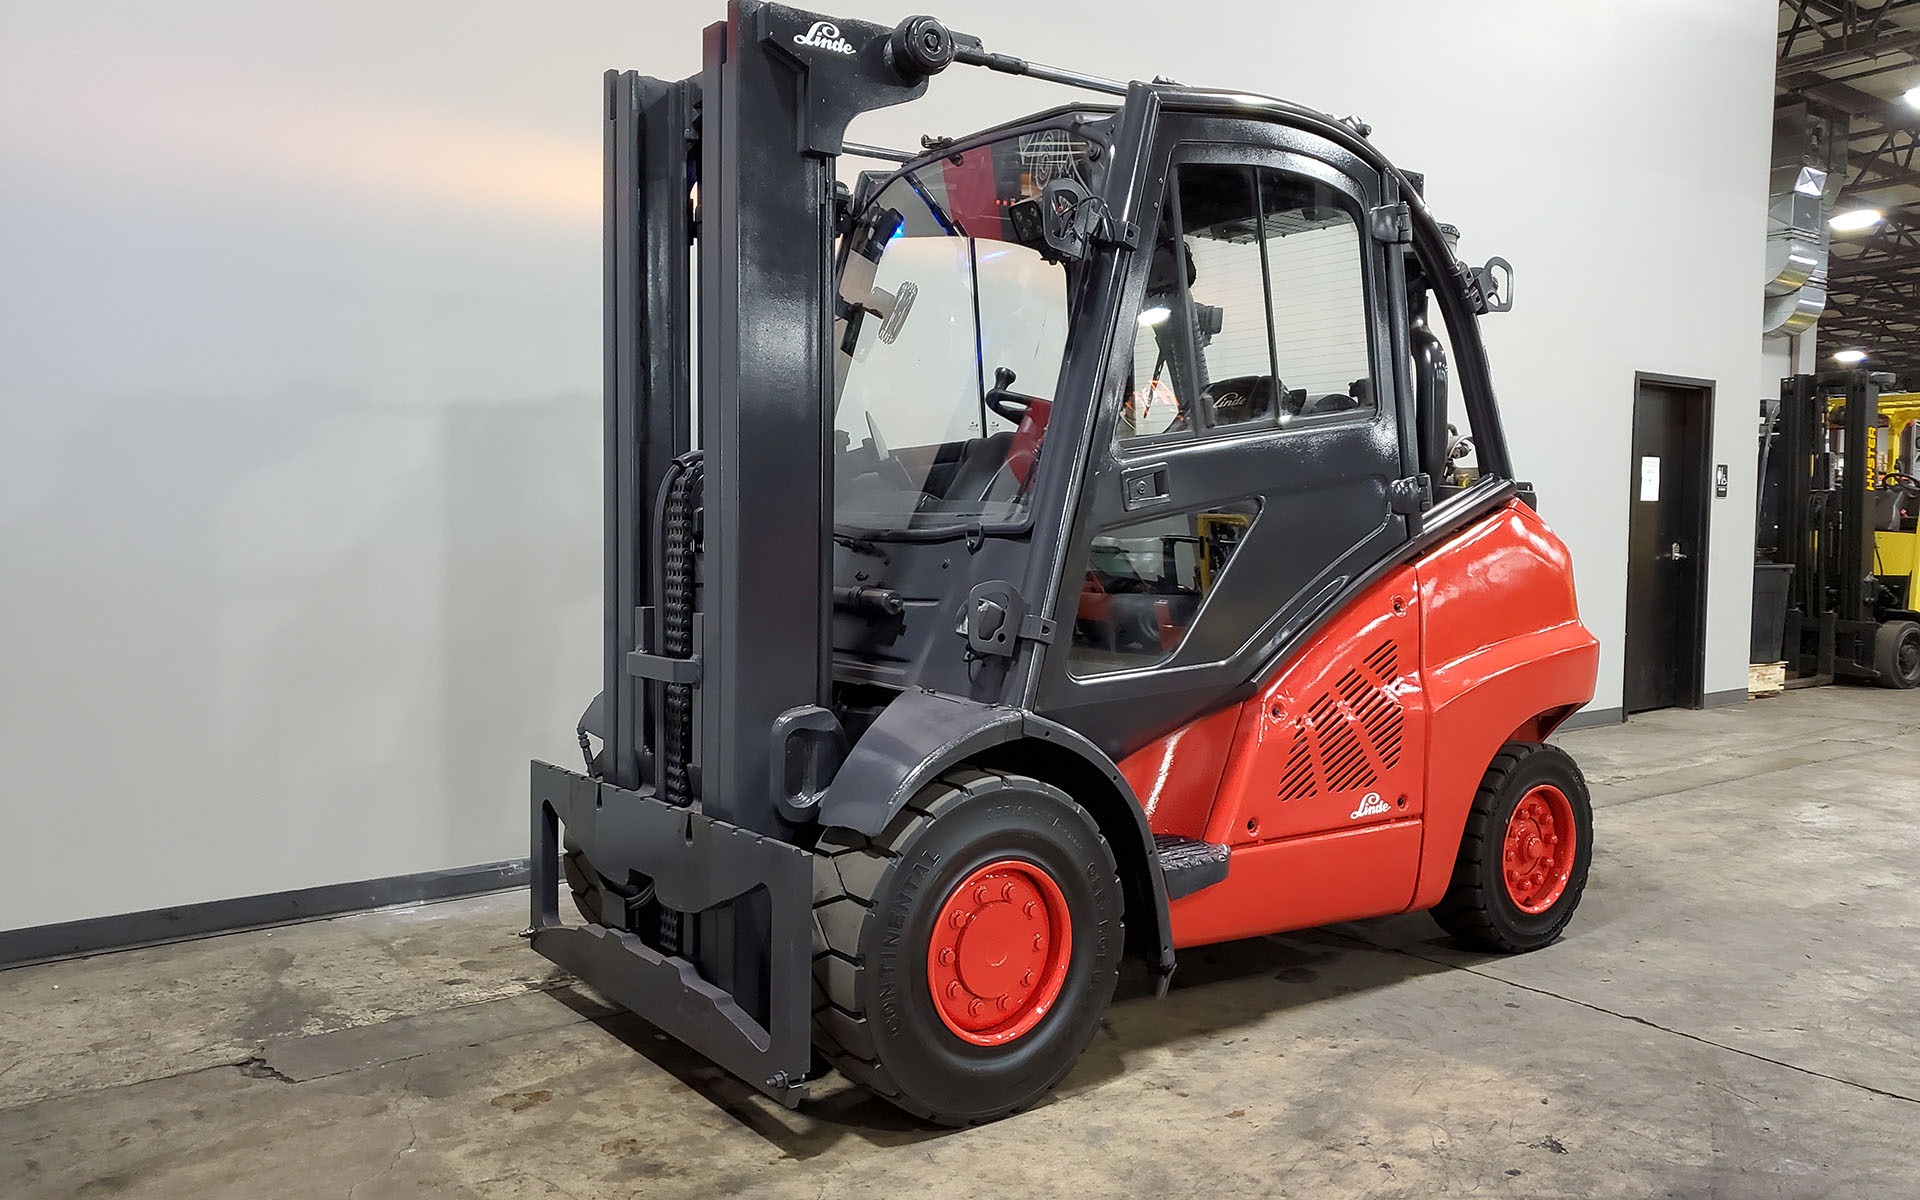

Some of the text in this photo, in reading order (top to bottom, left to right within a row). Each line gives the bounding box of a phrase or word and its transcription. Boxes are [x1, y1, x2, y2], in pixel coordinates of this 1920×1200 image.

[793, 21, 857, 55] Linde
[1212, 392, 1247, 409] Linde
[1866, 426, 1877, 492] HYSTER
[1350, 792, 1392, 819] Linde
[879, 850, 941, 1037] CONTINENTAL
